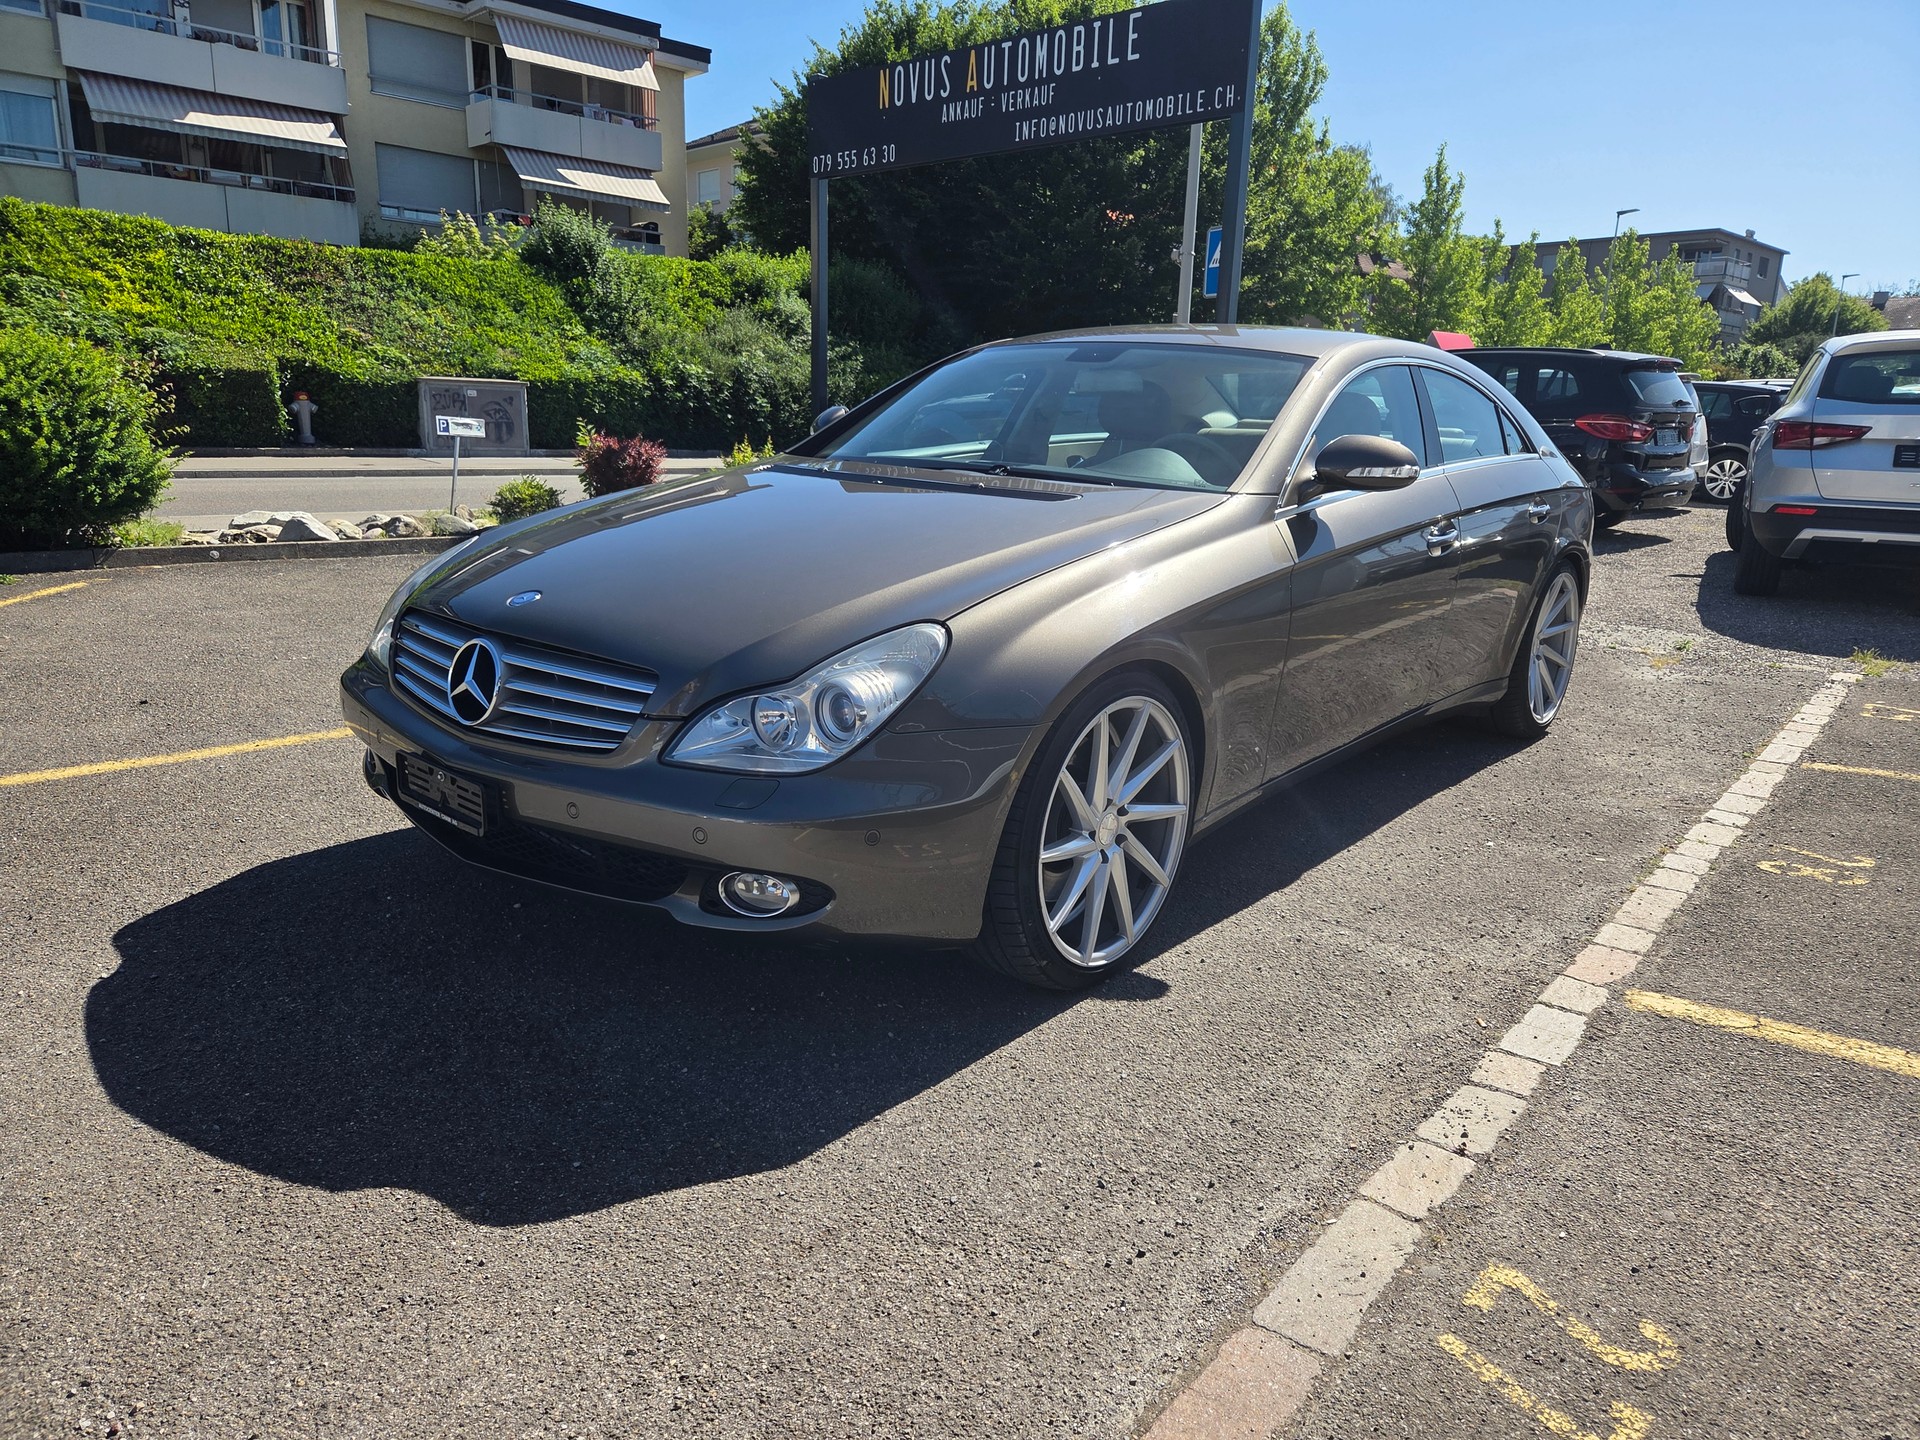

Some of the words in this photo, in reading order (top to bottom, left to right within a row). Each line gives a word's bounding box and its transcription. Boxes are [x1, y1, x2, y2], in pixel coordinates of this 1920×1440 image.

[879, 55, 951, 110] NOVUS
[966, 12, 1142, 93] AUTOMOBILE
[941, 97, 985, 124] ANKAUF
[1001, 83, 1056, 113] VERKAUF
[1015, 85, 1235, 142] INFO@NOVUSAUTOMOBILE.CH
[813, 154, 832, 174] 079
[837, 150, 857, 170] 555
[863, 147, 876, 166] 63
[882, 144, 896, 163] 30
[440, 419, 447, 431] P
